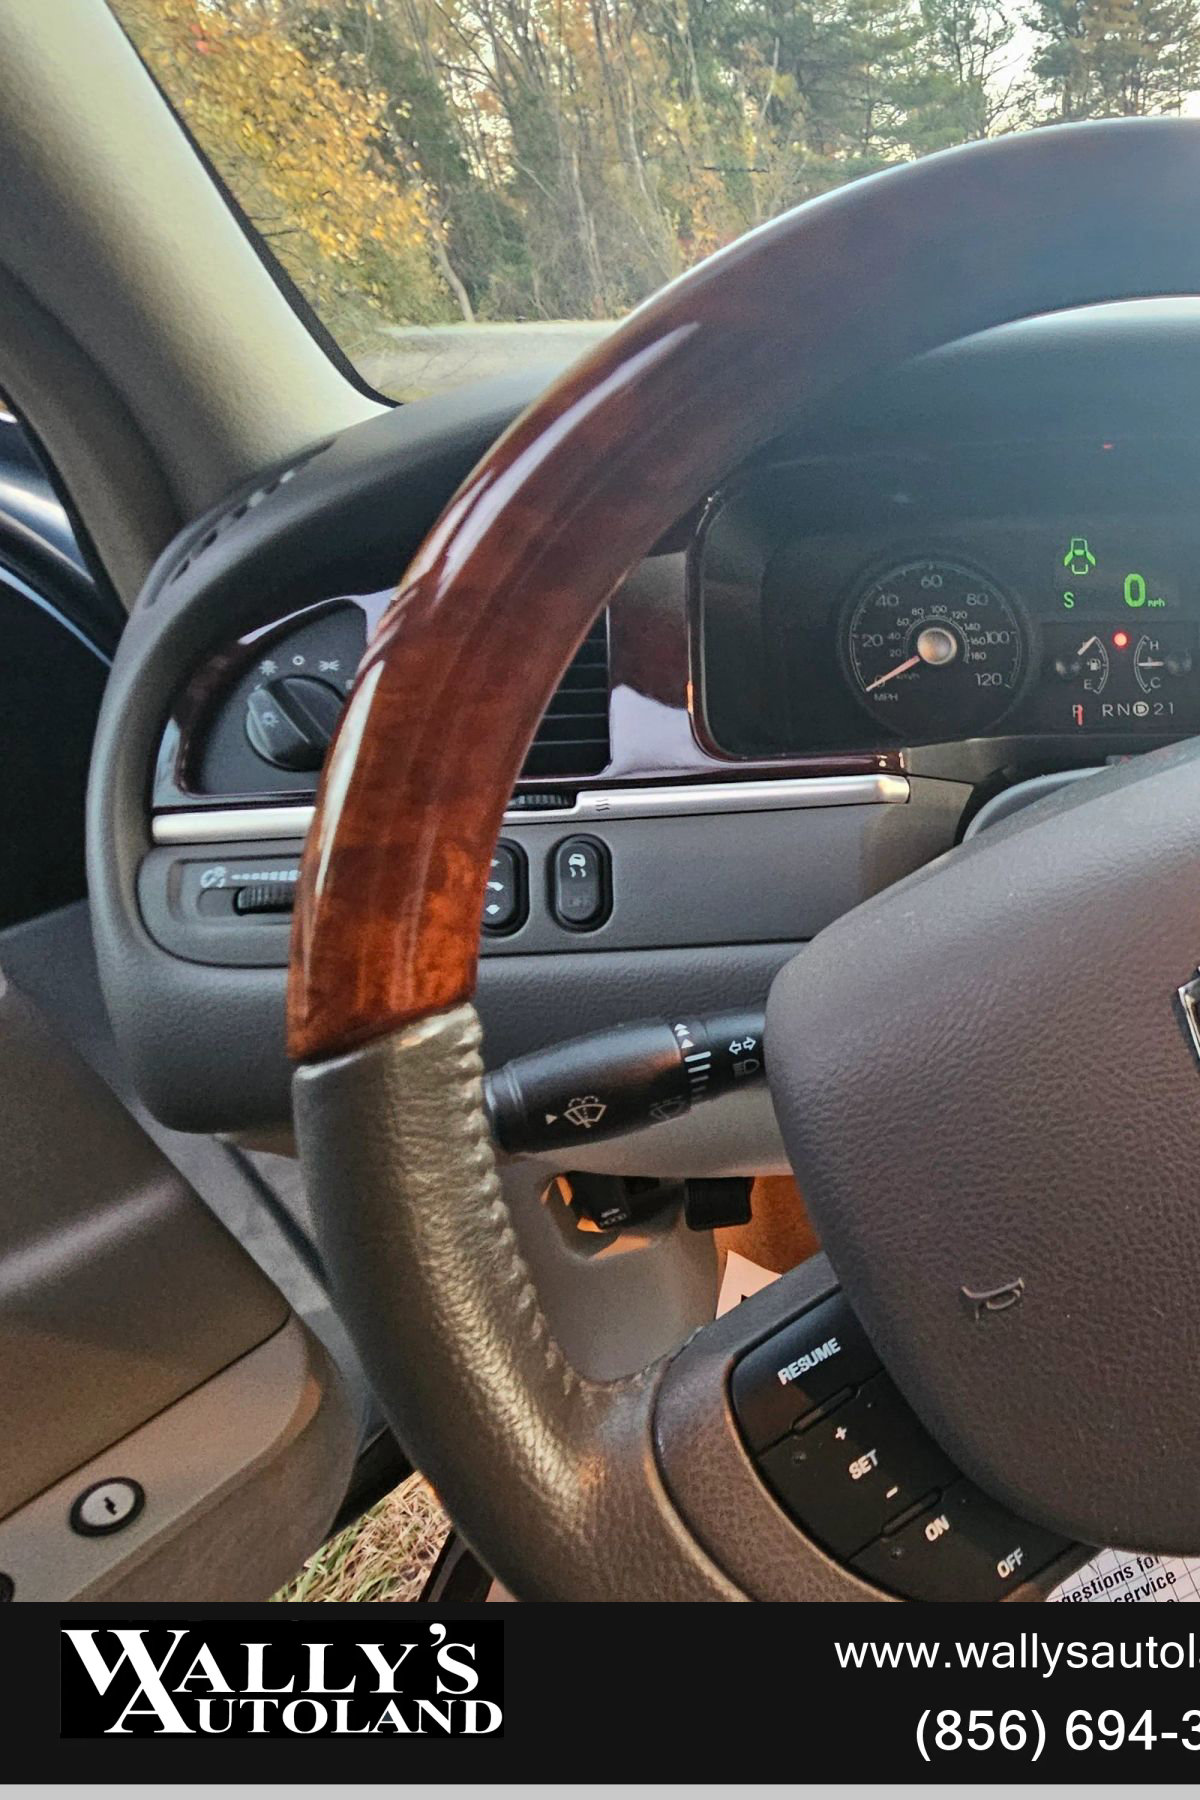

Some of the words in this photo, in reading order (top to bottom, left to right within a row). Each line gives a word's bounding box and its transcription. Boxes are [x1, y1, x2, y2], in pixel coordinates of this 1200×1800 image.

[1063, 591, 1075, 609] S
[1124, 573, 1146, 608] 0
[777, 1337, 841, 1386] RESUME
[848, 1449, 878, 1480] SET
[924, 1514, 950, 1542] ON
[996, 1547, 1024, 1579] OFF
[1056, 1565, 1134, 1602] gestions
